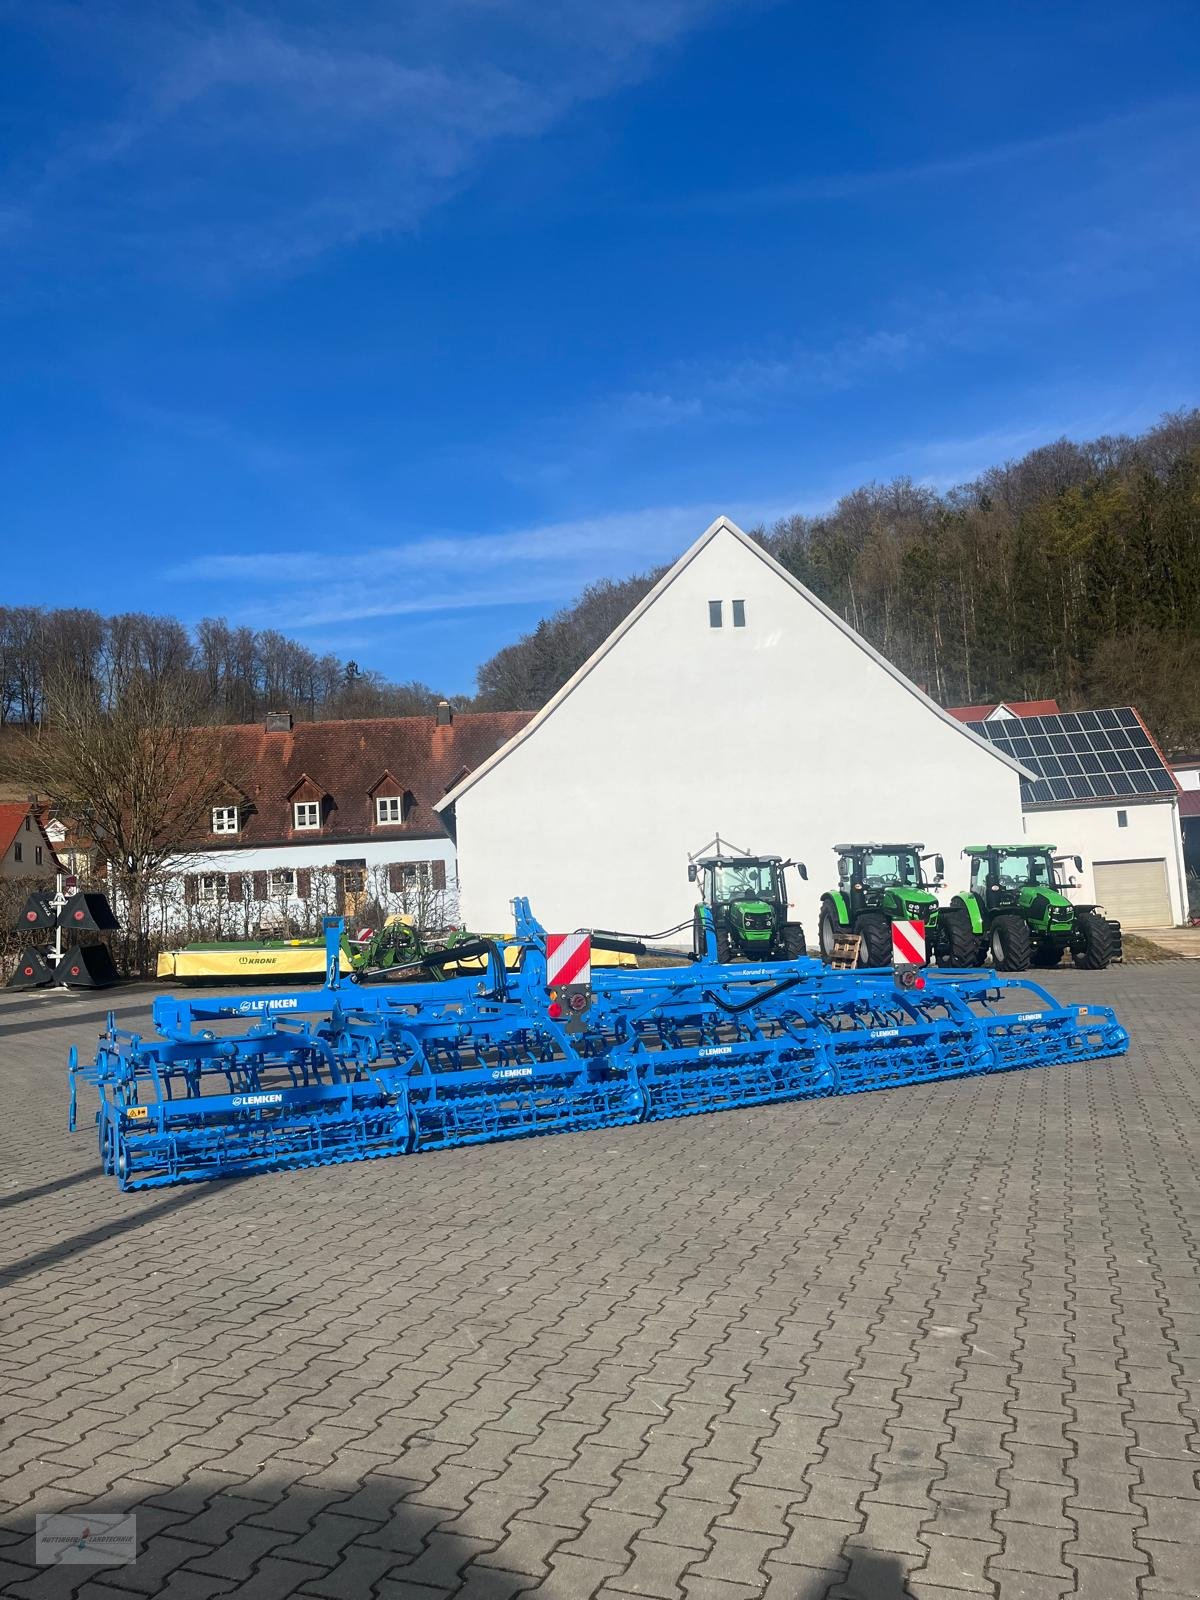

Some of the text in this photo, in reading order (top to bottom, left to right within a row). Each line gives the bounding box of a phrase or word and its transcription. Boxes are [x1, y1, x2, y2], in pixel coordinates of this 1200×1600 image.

[252, 998, 298, 1009] LEMKEN
[705, 1047, 732, 1056] LEMKEN
[500, 1068, 532, 1078] LEMKEN
[242, 1094, 282, 1105] LEMKEN
